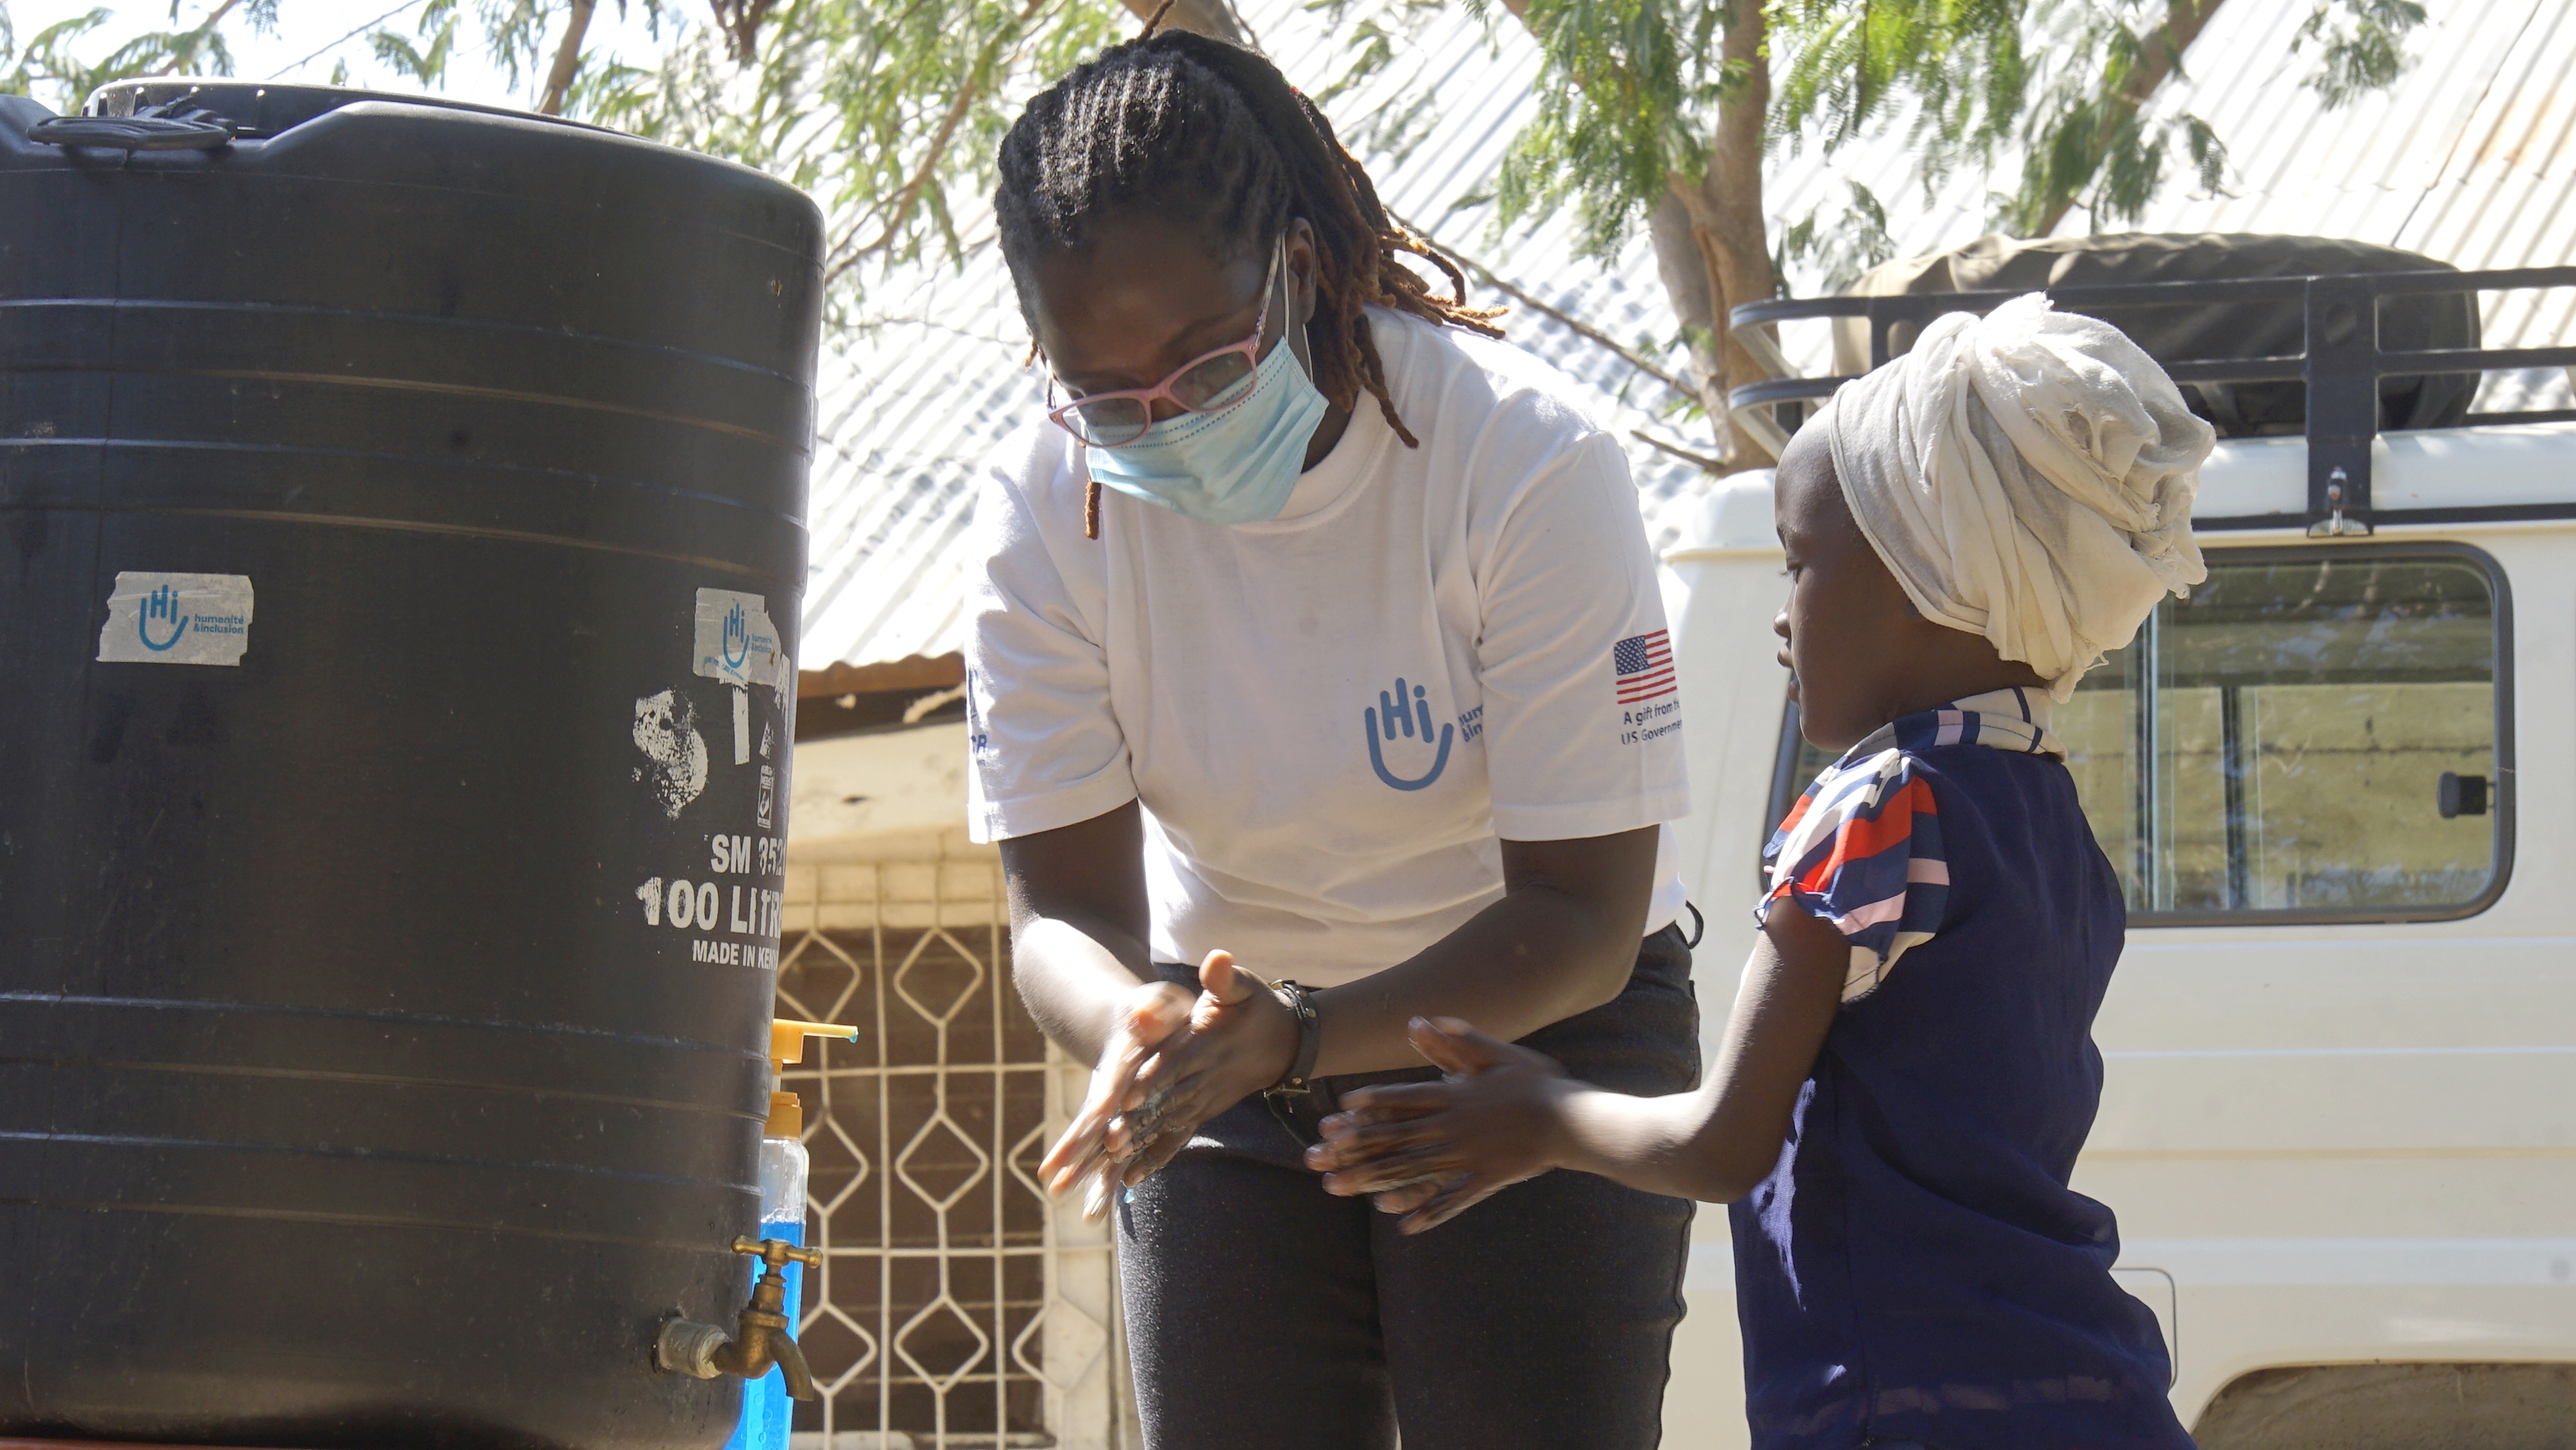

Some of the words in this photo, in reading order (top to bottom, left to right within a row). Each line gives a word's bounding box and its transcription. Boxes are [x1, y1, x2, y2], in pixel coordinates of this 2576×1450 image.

[1624, 711, 1633, 725] A
[1635, 706, 1653, 726] gift
[1654, 703, 1673, 717] from
[1621, 731, 1638, 745] US
[710, 834, 751, 874] SM
[635, 877, 719, 931] 100
[692, 940, 740, 966] MADE
[742, 944, 755, 968] IN
